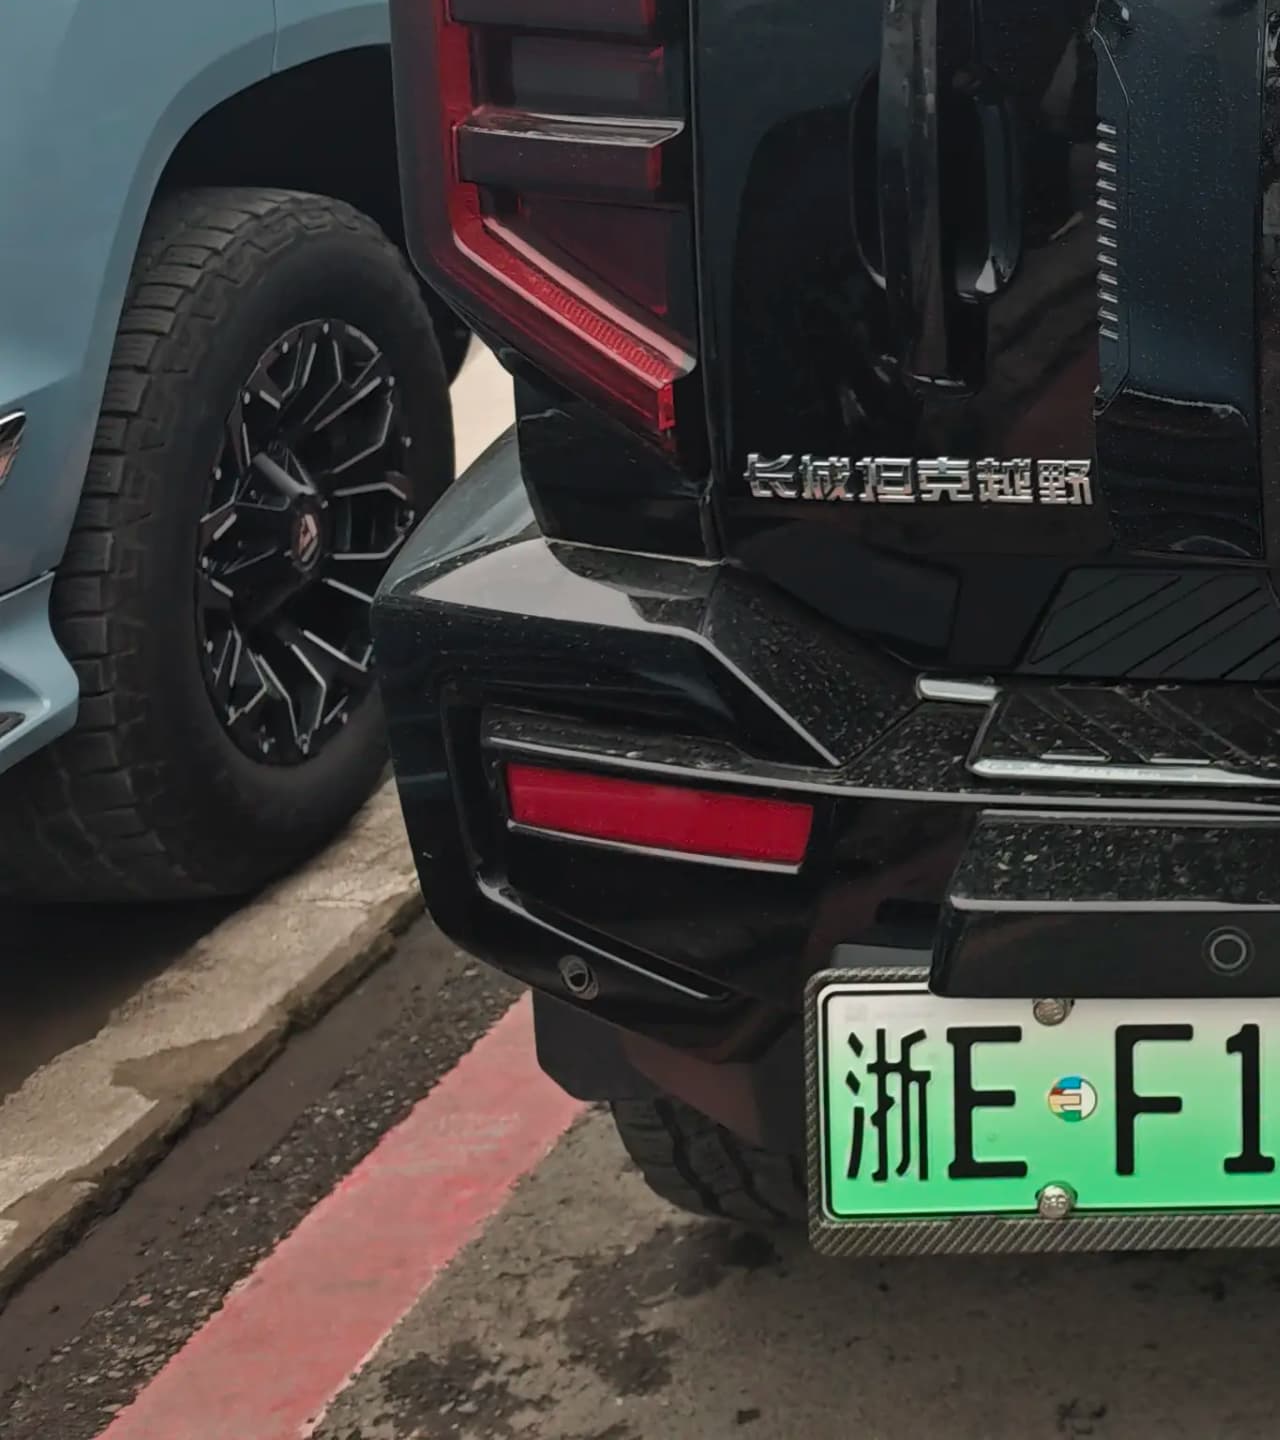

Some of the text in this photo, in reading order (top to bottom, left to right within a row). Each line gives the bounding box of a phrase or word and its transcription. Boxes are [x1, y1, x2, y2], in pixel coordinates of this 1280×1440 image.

[743, 453, 1094, 505] 长城坦克越野
